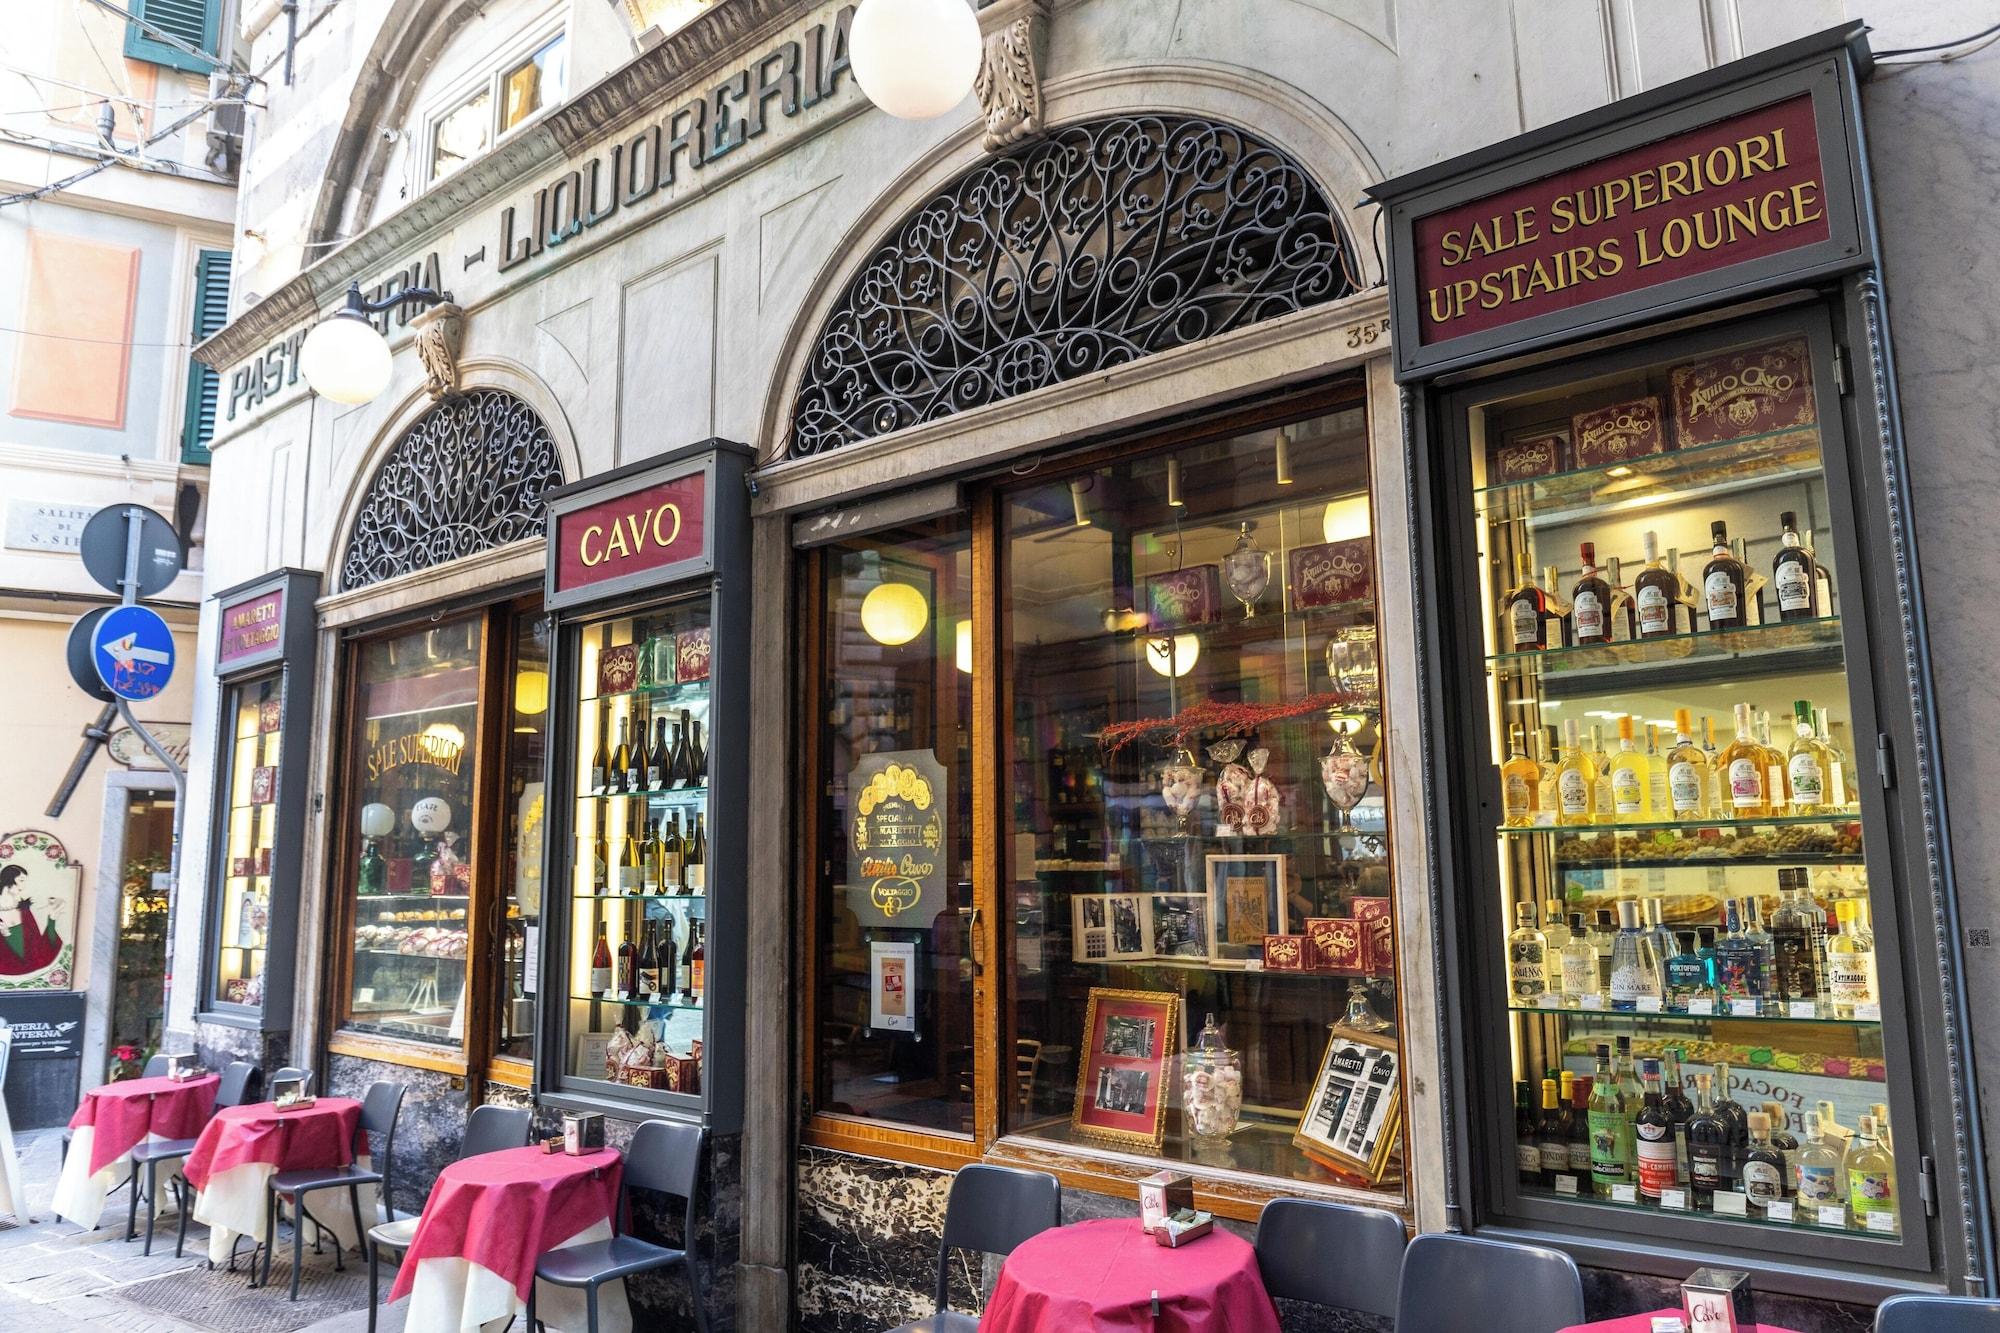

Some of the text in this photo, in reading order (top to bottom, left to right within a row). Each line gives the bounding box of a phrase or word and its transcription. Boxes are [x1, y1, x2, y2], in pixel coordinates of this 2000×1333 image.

[498, 4, 856, 273] LIQUORERIA
[1440, 127, 1790, 268] SALE SUPERIORI
[1428, 180, 1823, 324] UPSTAIRS LOUNGE
[580, 502, 681, 568] CAVO
[368, 733, 464, 781] SALE SUPERIORI
[878, 887, 913, 896] VOLTAGGIO
[1627, 984, 1652, 992] MARE
[1669, 964, 1700, 972] PORTOFINO
[1333, 1054, 1391, 1077] AMARETTI CAVO
